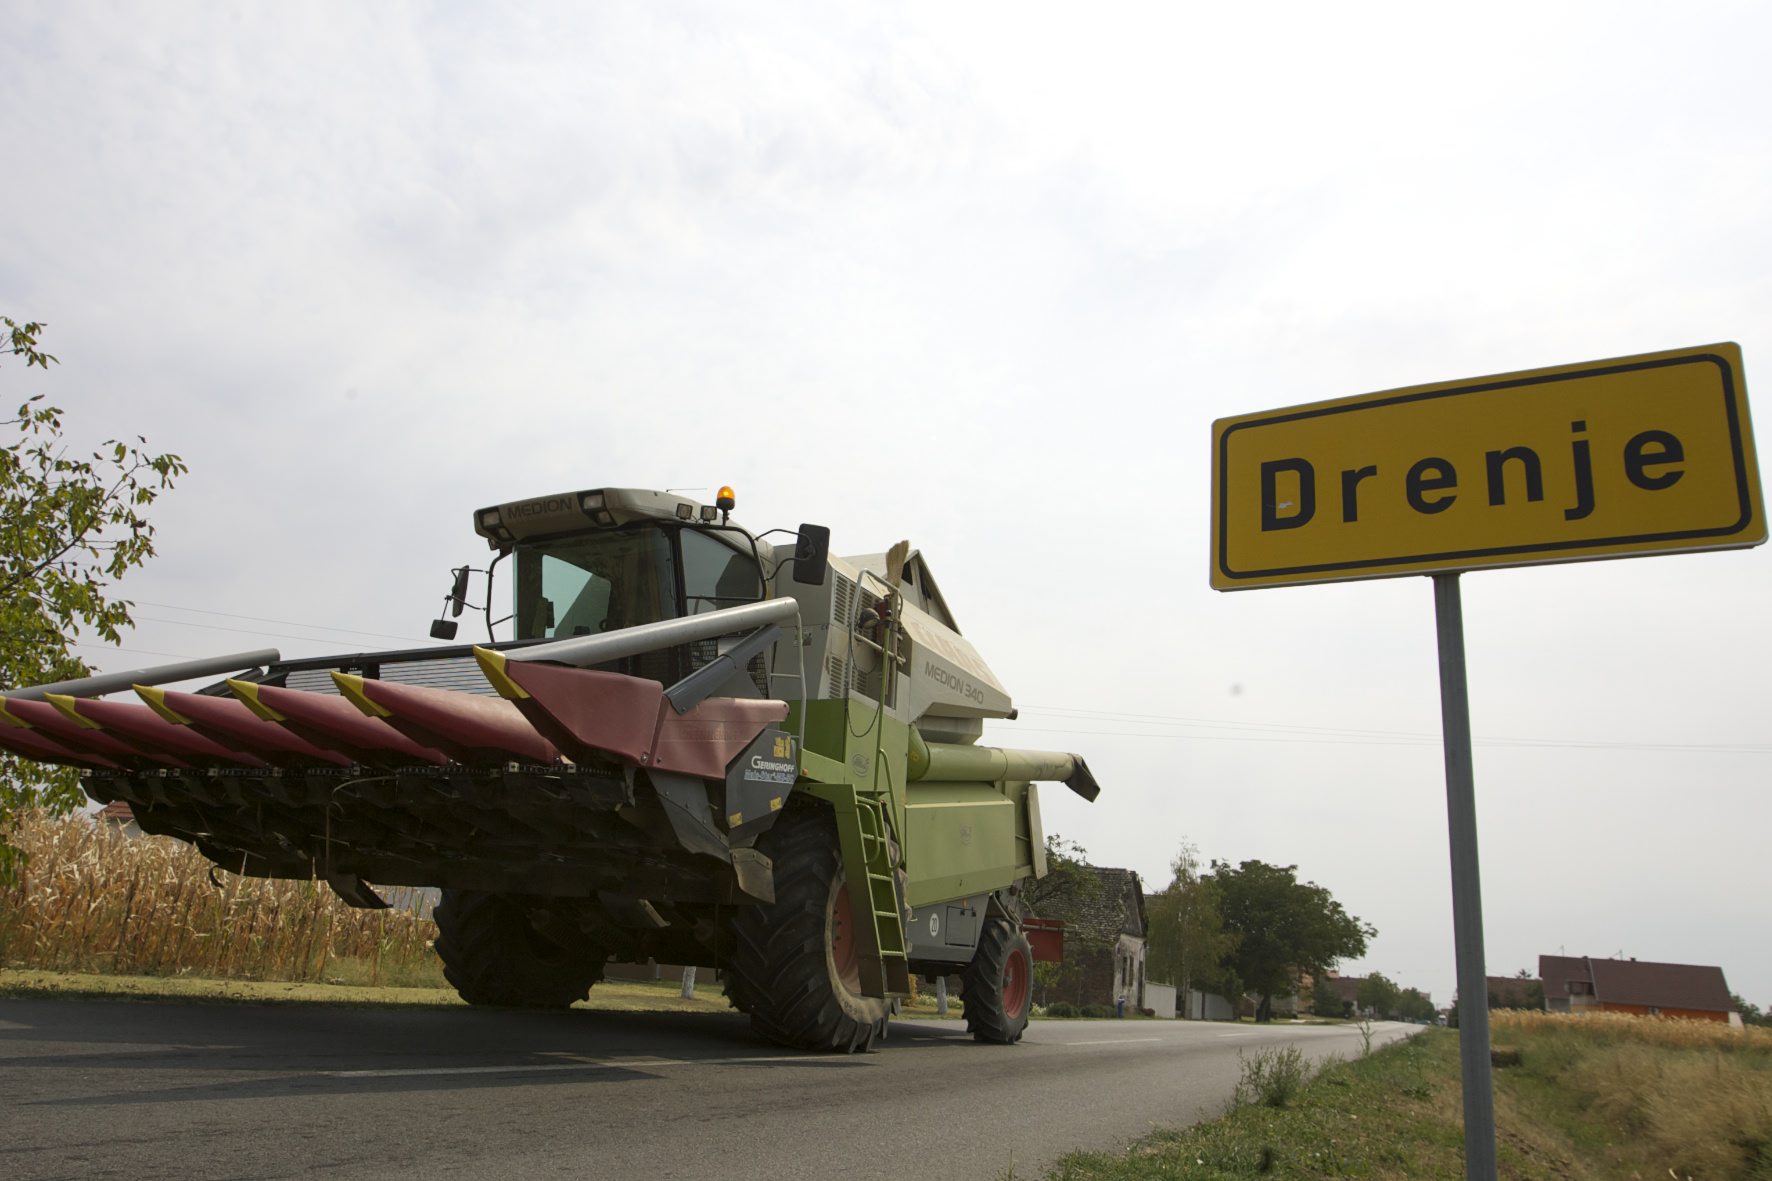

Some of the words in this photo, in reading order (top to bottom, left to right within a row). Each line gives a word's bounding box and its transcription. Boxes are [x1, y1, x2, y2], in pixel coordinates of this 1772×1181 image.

[1260, 420, 1685, 531] Drenje
[508, 498, 571, 519] MEDION
[925, 661, 964, 693] MEDION
[965, 684, 984, 704] 340
[751, 755, 795, 773] GERINGHOFF
